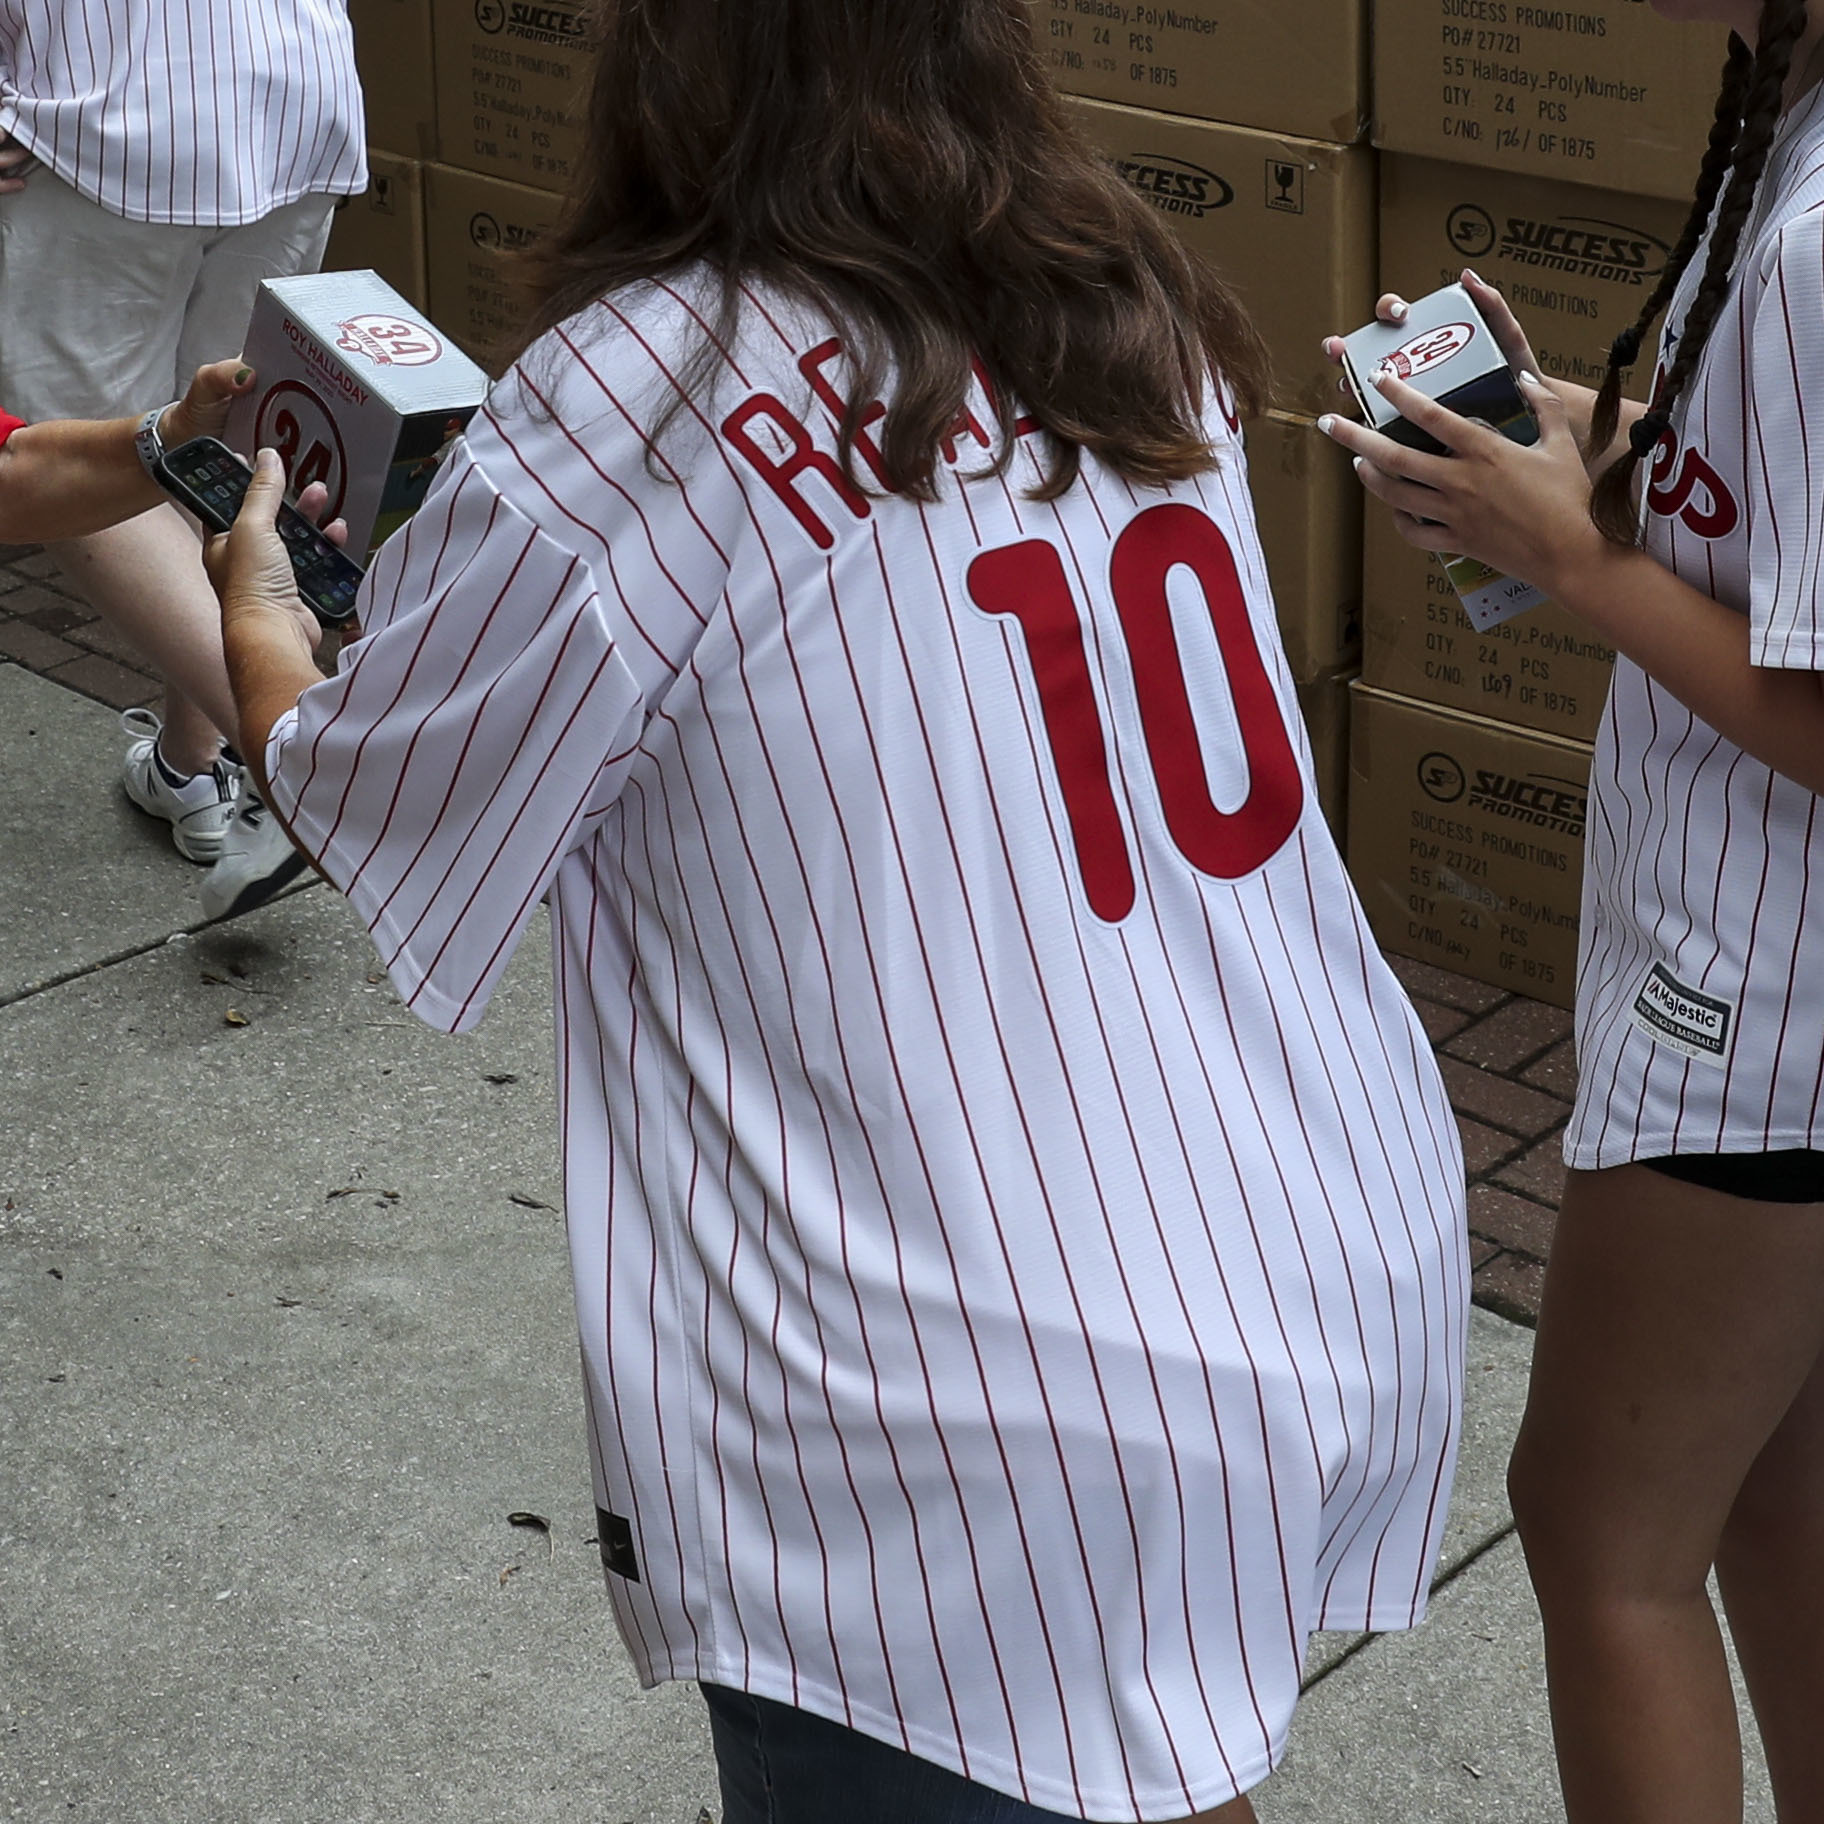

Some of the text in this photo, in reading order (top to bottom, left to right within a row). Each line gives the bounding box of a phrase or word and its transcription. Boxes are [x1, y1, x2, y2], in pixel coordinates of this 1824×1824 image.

[1515, 5, 1607, 38] PROMOTIONS
[1093, 26, 1154, 54] 24 PCS
[1441, 24, 1522, 55] PO# 27721
[1129, 62, 1147, 83] OF
[1148, 65, 1178, 88] 1875
[1494, 93, 1569, 123] 24 PCS
[1538, 133, 1597, 161] OF 1875
[1501, 217, 1652, 269] SUCCESS
[1497, 244, 1644, 287] PROMOTIONS
[1511, 281, 1600, 320] PROMOTIONS
[368, 324, 432, 356] 34
[1410, 330, 1460, 368] 34
[282, 317, 307, 349] ROY
[307, 342, 369, 407] HALLADAY
[1478, 644, 1550, 681] 24 PCS
[965, 501, 1305, 925] 10
[1520, 685, 1538, 705] OF
[1543, 691, 1577, 716] 1875
[1411, 810, 1568, 873] SUCCESS PROMOTIONS
[1446, 849, 1489, 878] 27721
[1460, 909, 1528, 948] 24 PCS
[1499, 950, 1556, 985] OF 1875
[1657, 985, 1717, 1029] Majestic
[1676, 1026, 1721, 1050] BASEBALL
